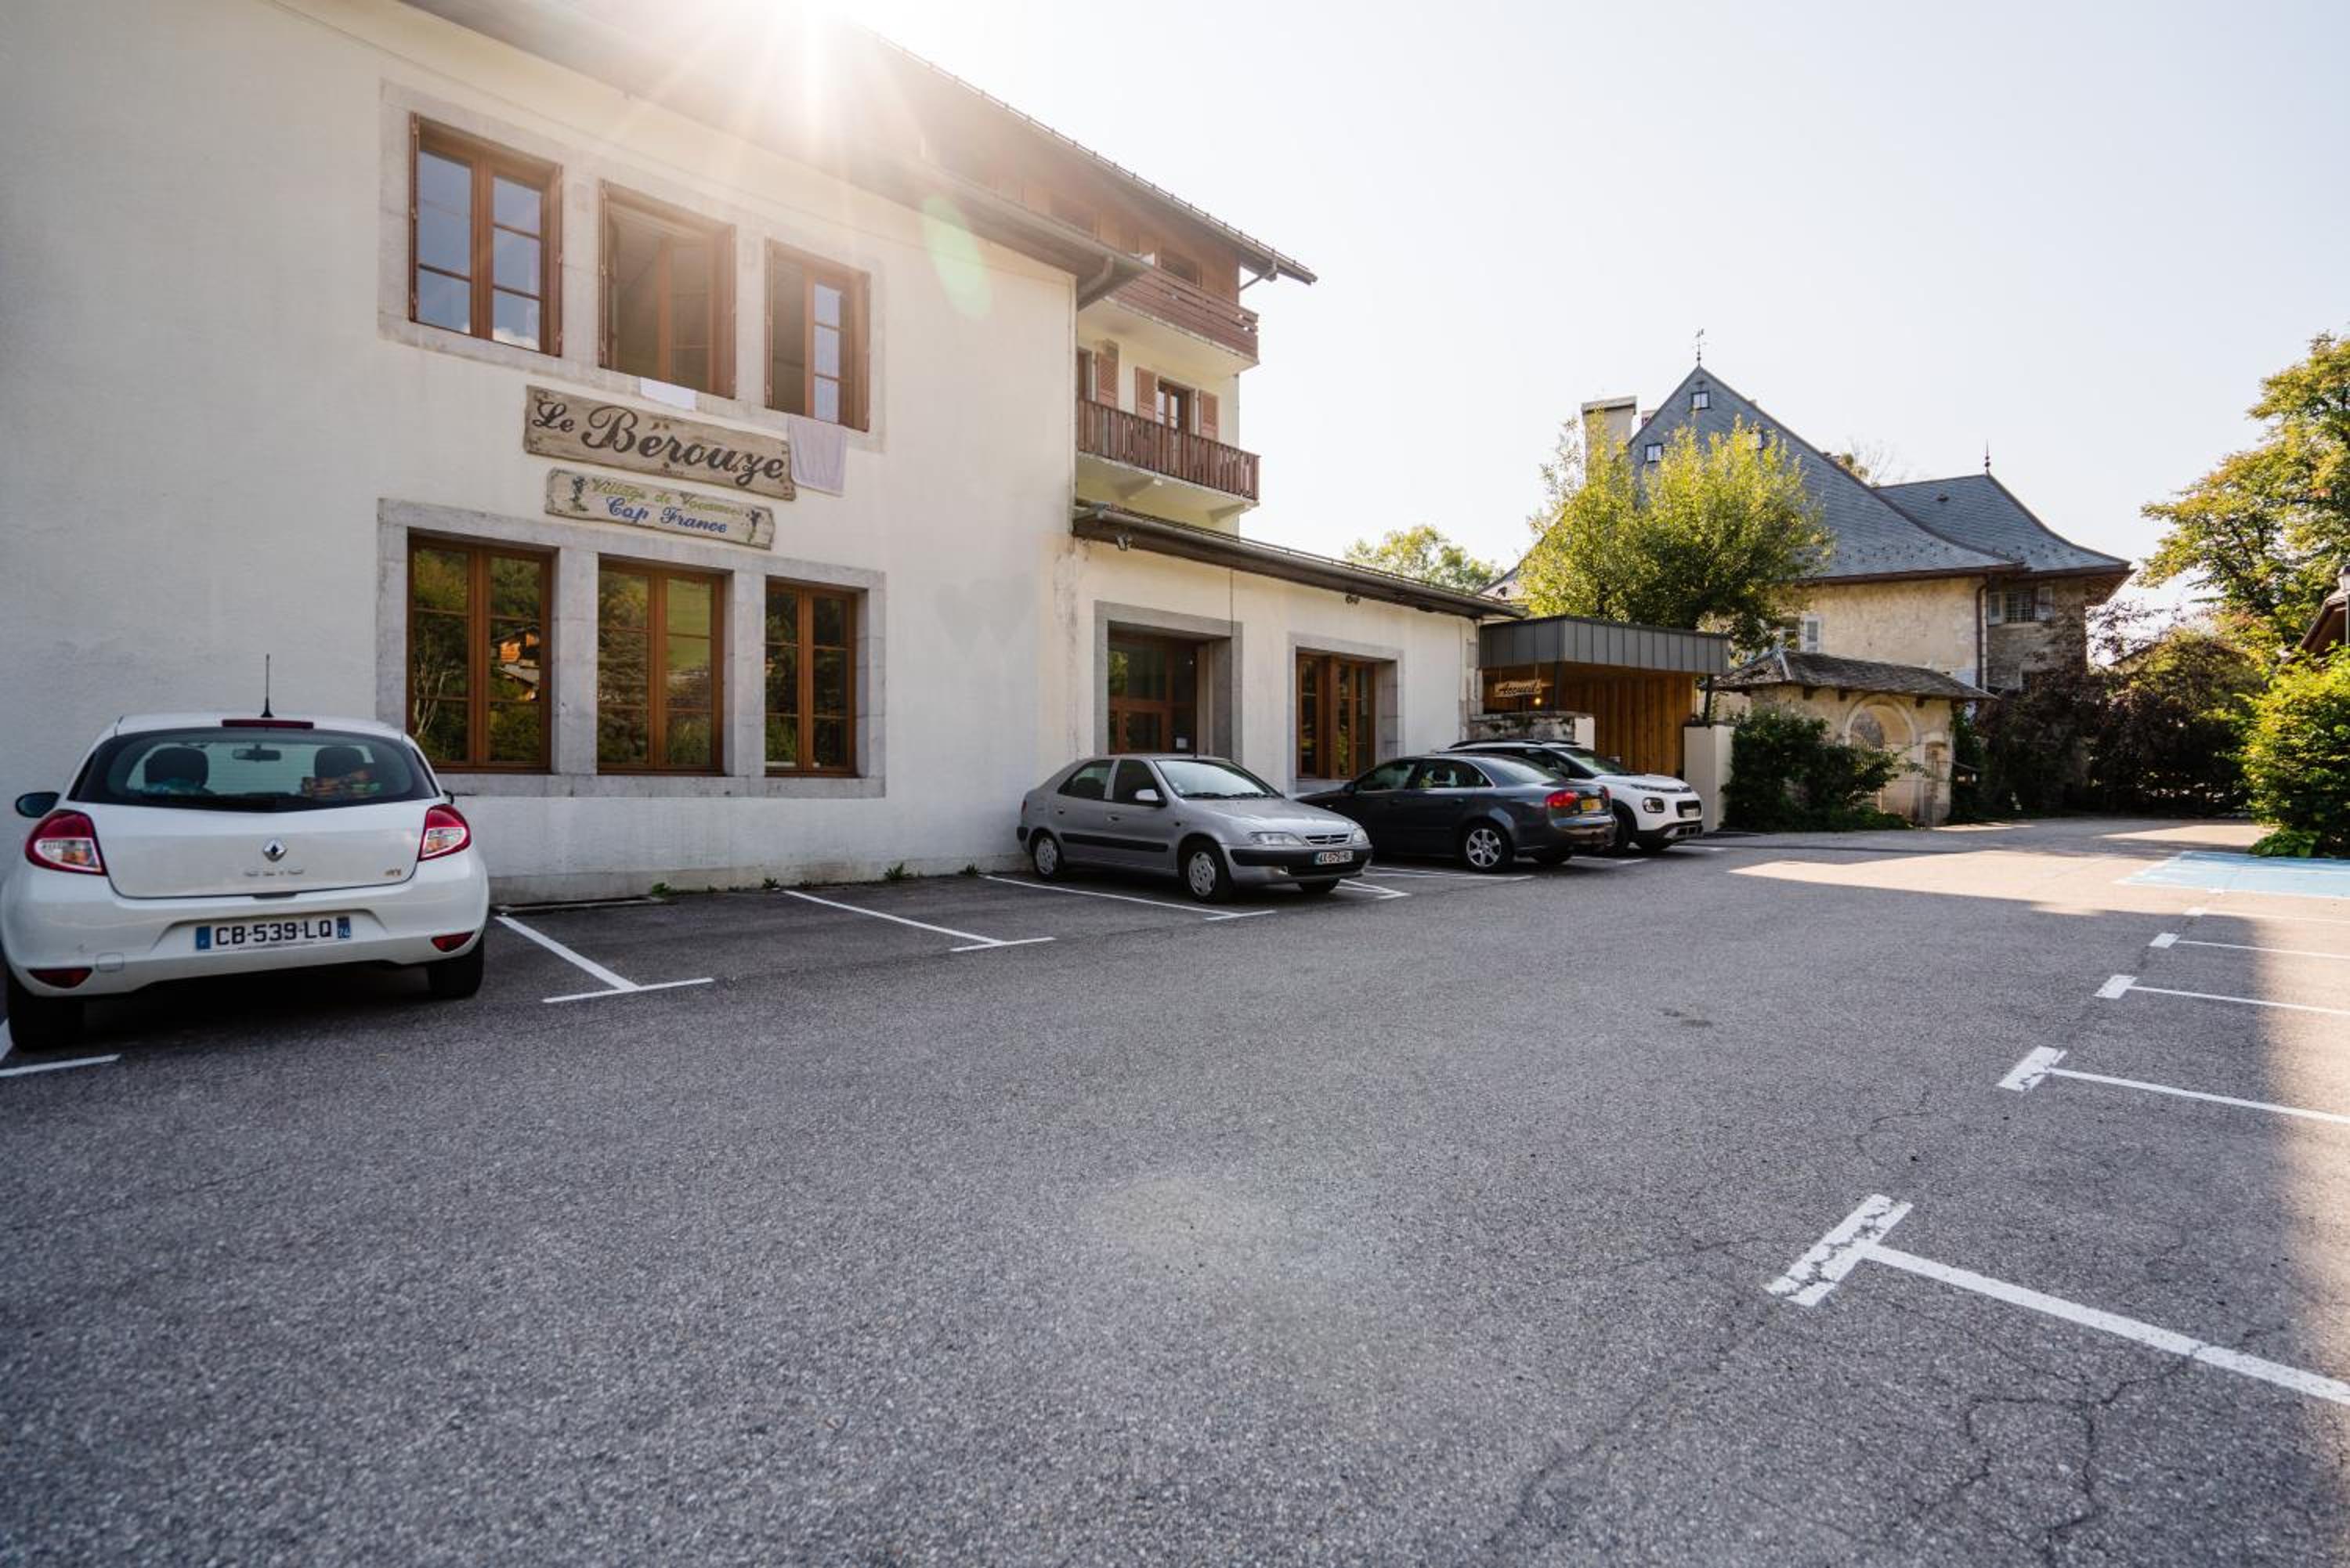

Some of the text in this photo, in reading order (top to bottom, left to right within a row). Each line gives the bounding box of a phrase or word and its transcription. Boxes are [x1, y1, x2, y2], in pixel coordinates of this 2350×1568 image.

[533, 401, 575, 432] Le
[606, 497, 728, 533] Cap France
[215, 919, 331, 945] CB-539-LQ
